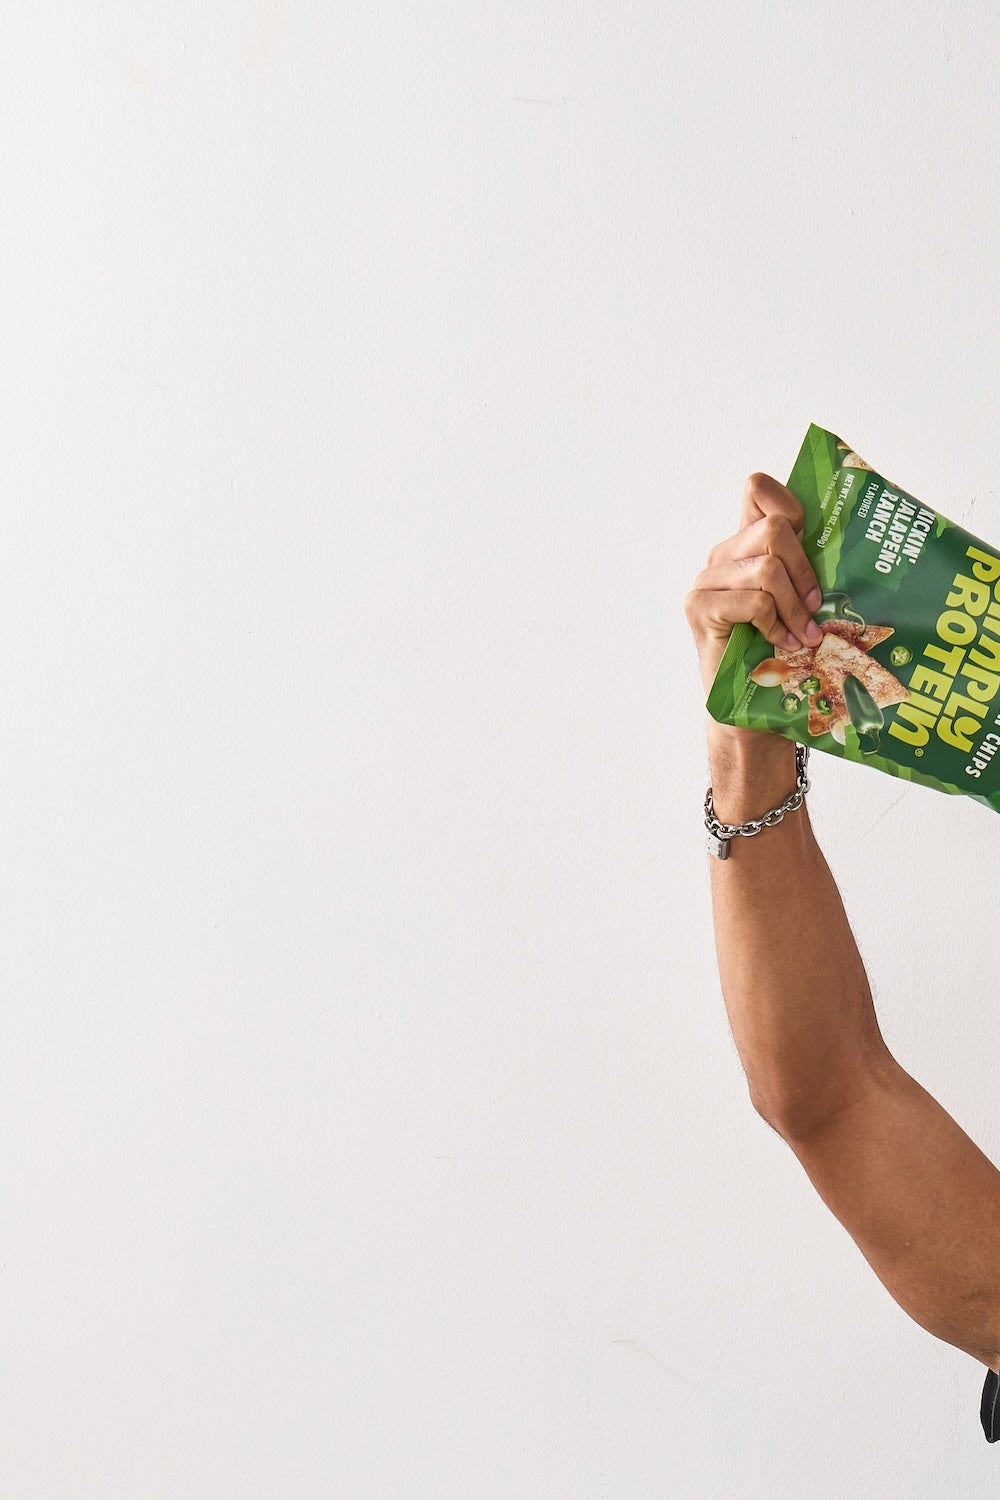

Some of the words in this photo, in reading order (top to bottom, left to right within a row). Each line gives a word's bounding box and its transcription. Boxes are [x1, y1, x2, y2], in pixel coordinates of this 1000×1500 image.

[839, 487, 849, 499] WT.
[844, 473, 855, 488] NET
[857, 482, 879, 518] FLAVORED
[865, 489, 899, 543] RANCH
[816, 526, 833, 548] (130g)
[874, 498, 917, 574] JALAPEÑO
[902, 508, 936, 564] KICKIN'
